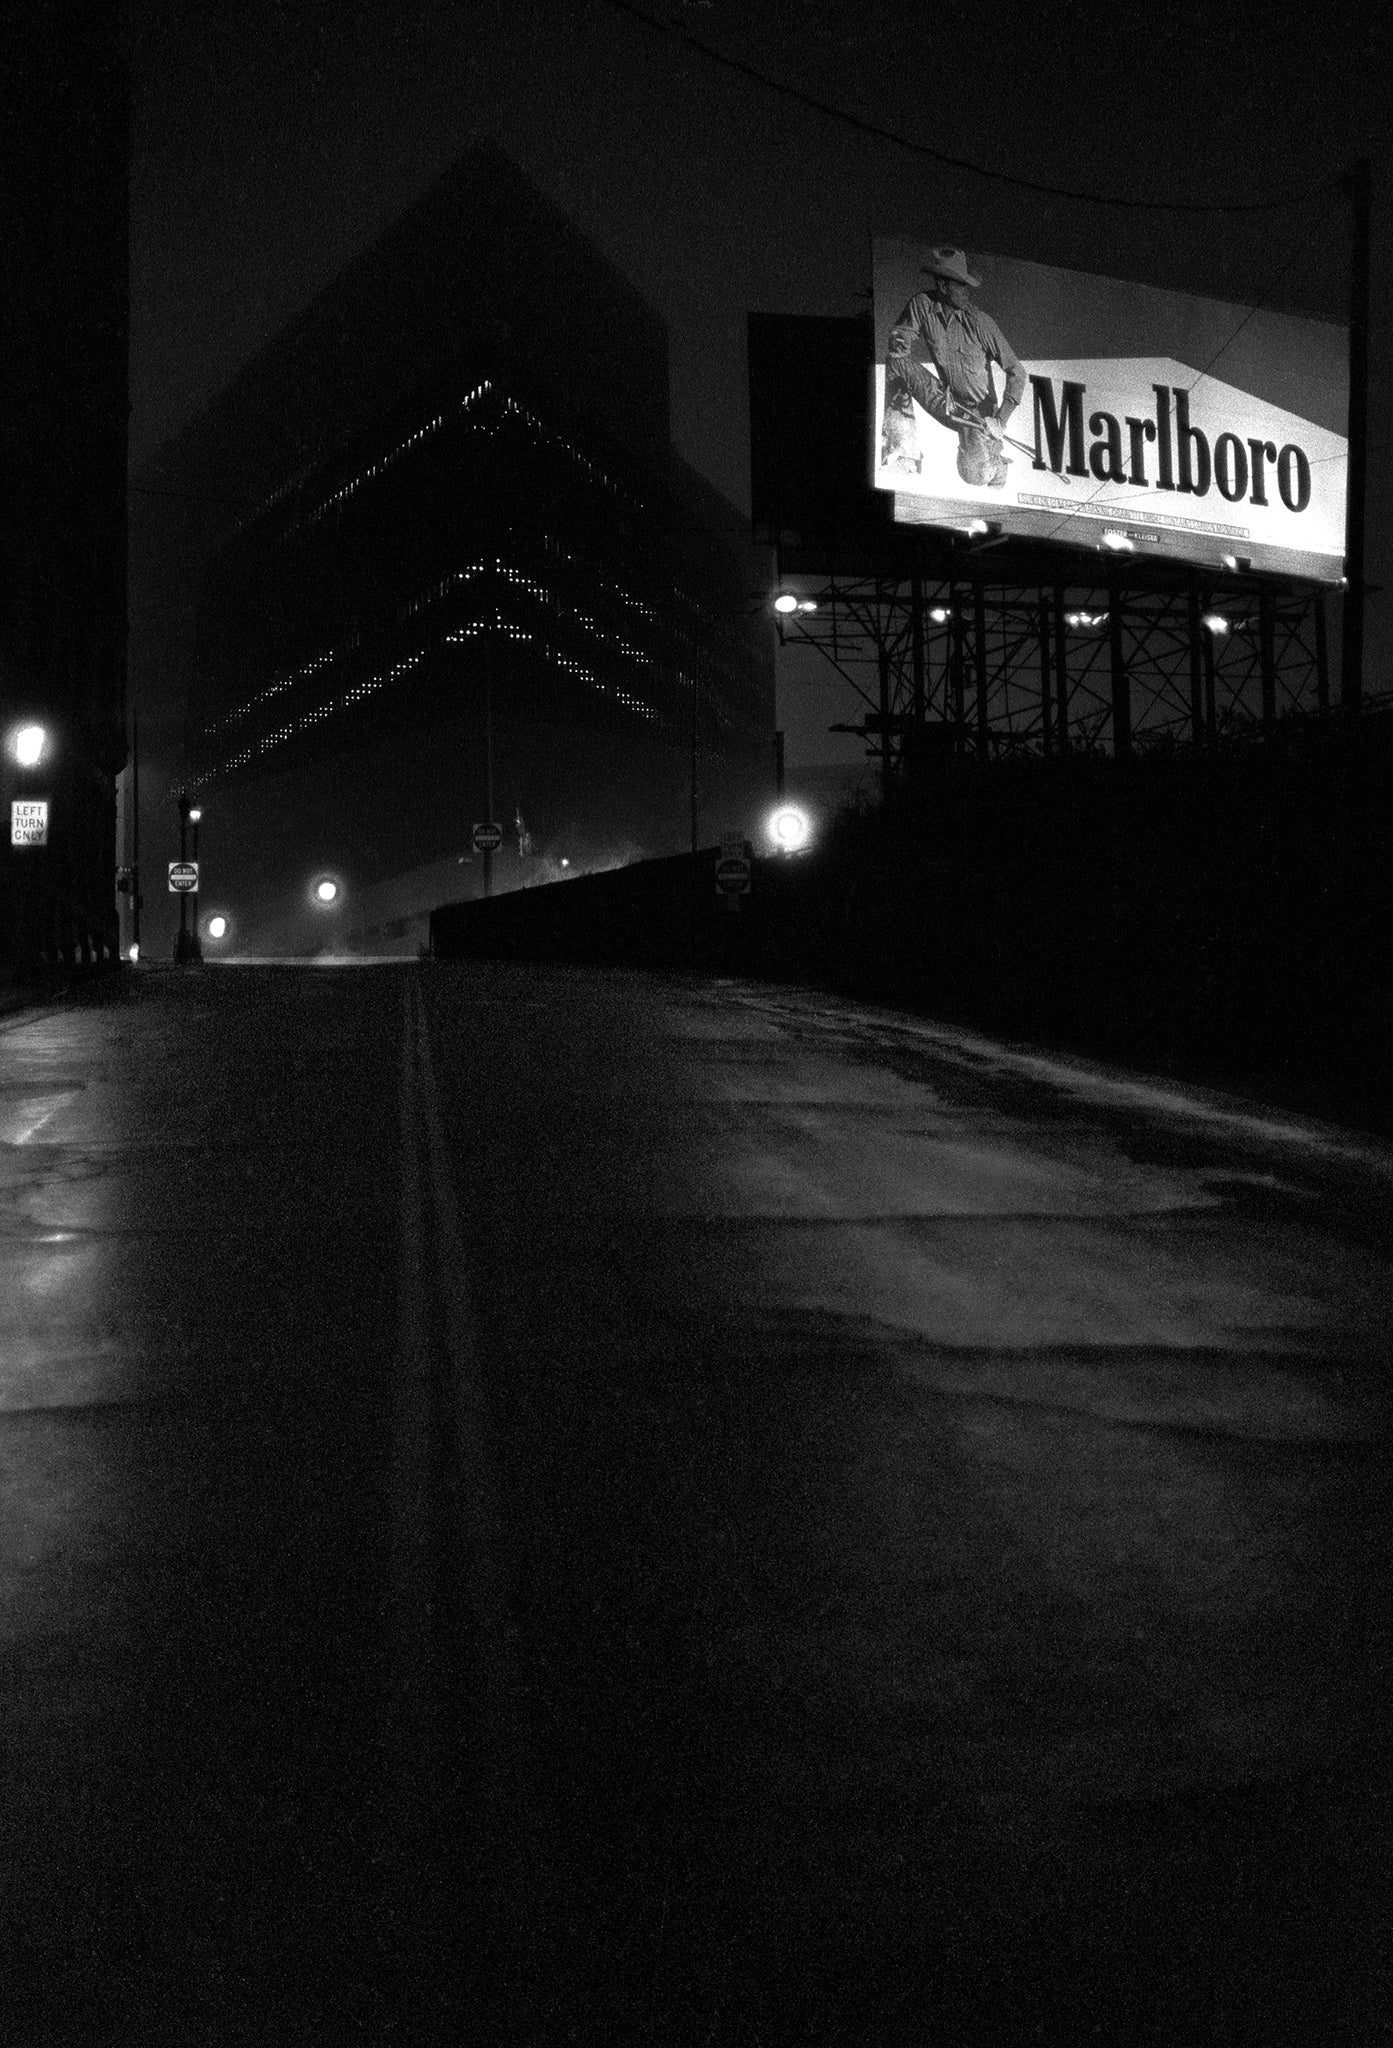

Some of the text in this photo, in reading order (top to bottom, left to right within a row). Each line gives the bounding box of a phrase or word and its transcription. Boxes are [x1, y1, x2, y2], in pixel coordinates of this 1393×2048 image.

[1028, 374, 1312, 513] Marlboro
[16, 806, 43, 816] LEFT
[15, 818, 44, 828] TURN
